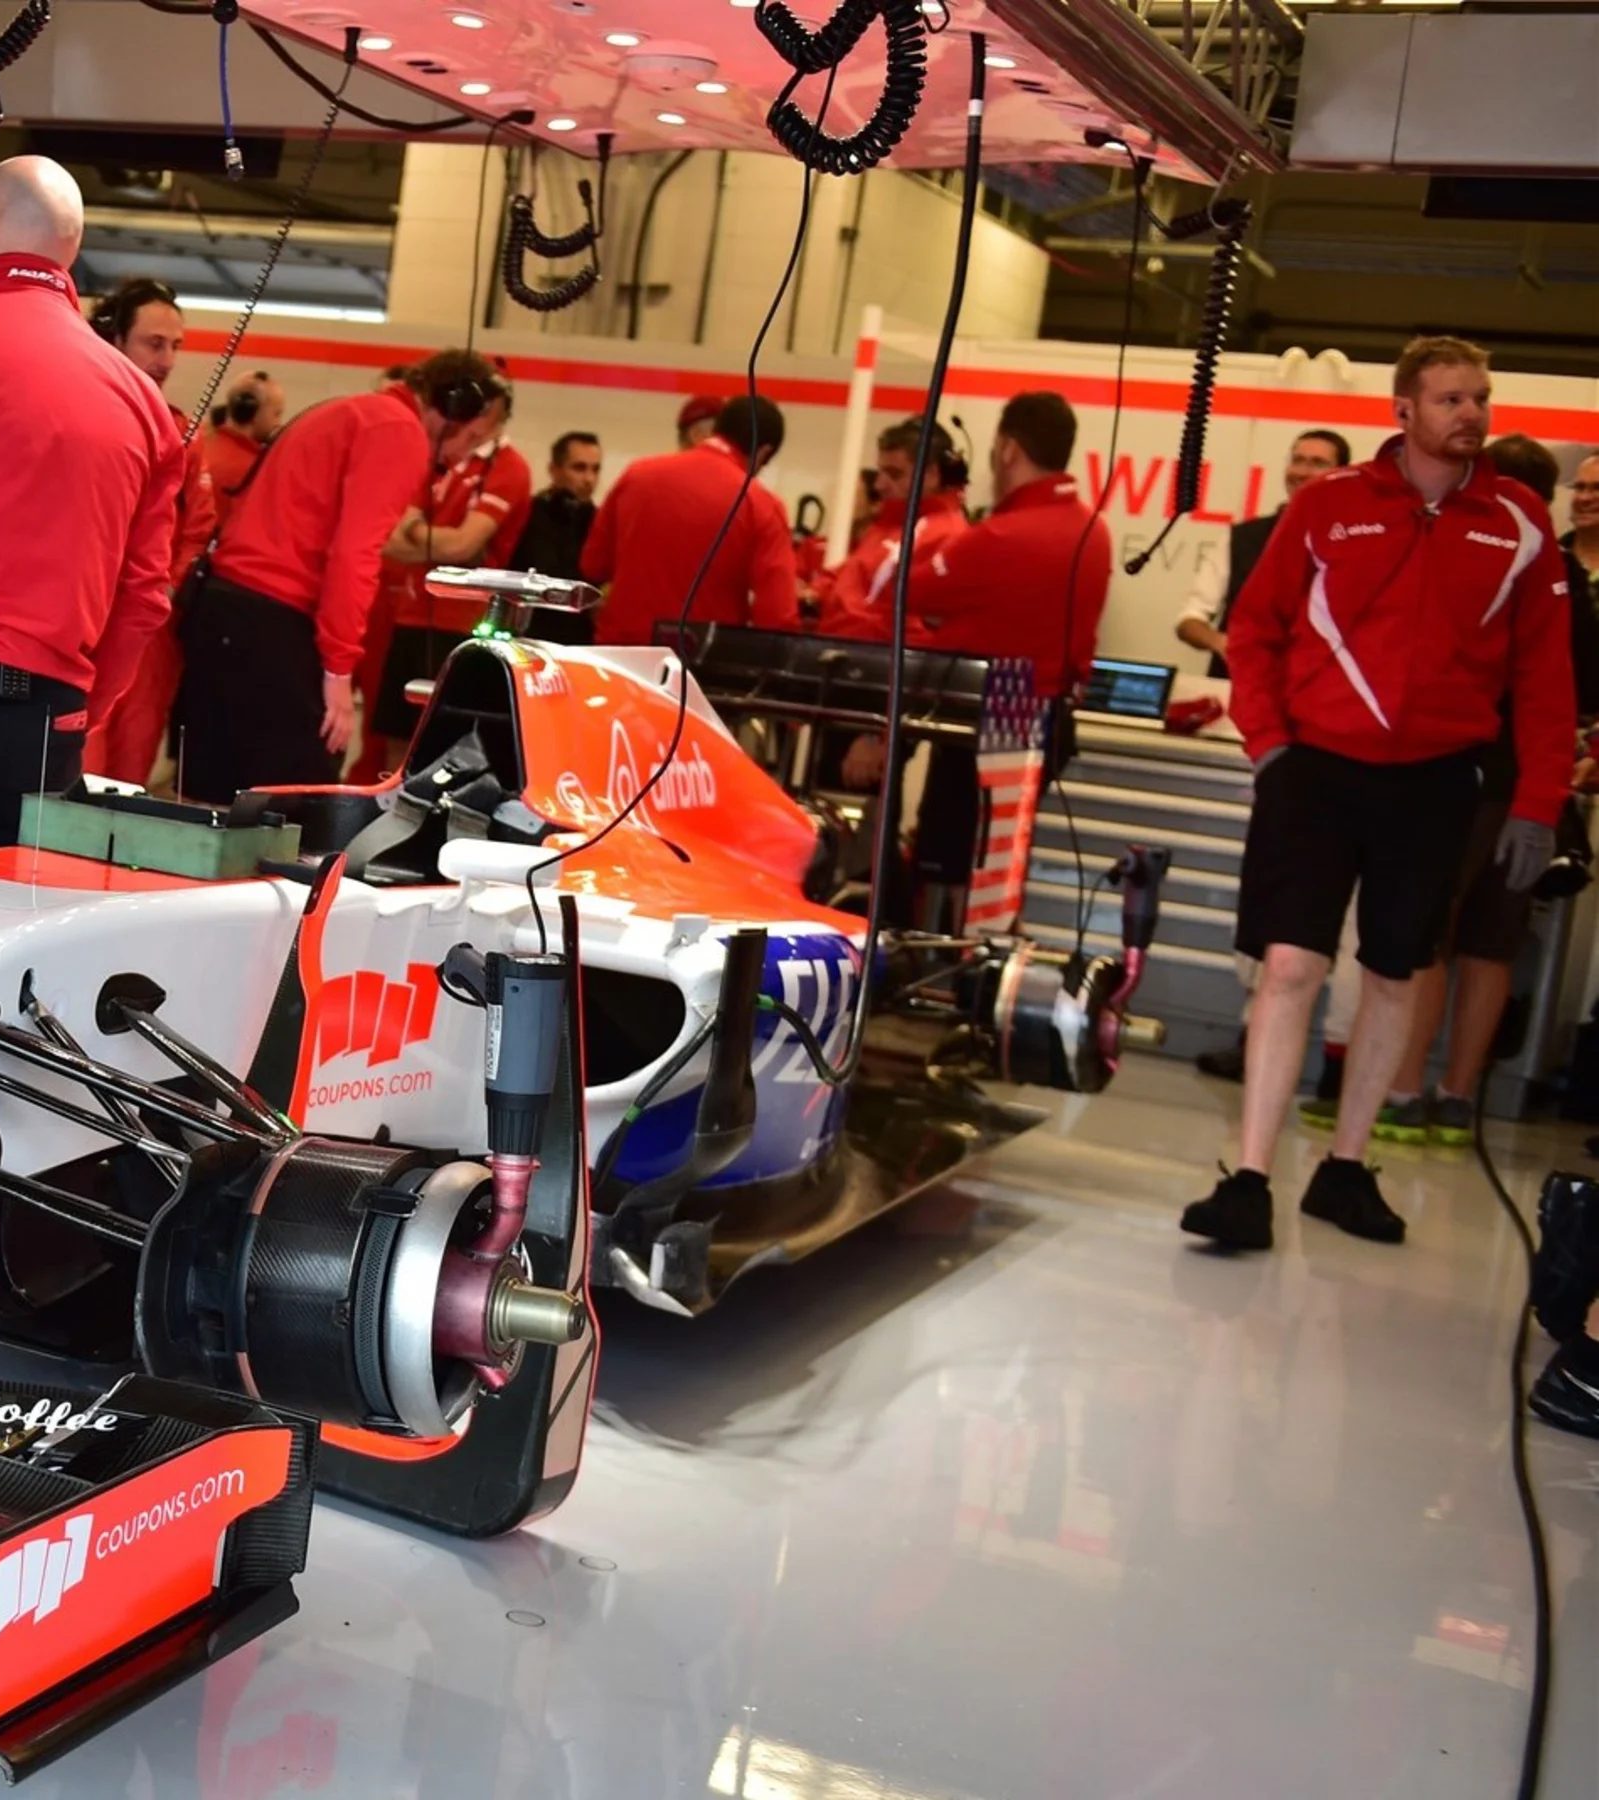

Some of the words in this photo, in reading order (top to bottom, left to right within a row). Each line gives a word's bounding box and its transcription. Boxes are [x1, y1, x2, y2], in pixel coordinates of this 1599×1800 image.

[650, 740, 718, 812] airbnb
[306, 1070, 432, 1108] COUPONS.com
[96, 1469, 245, 1560] COUPONS.com
